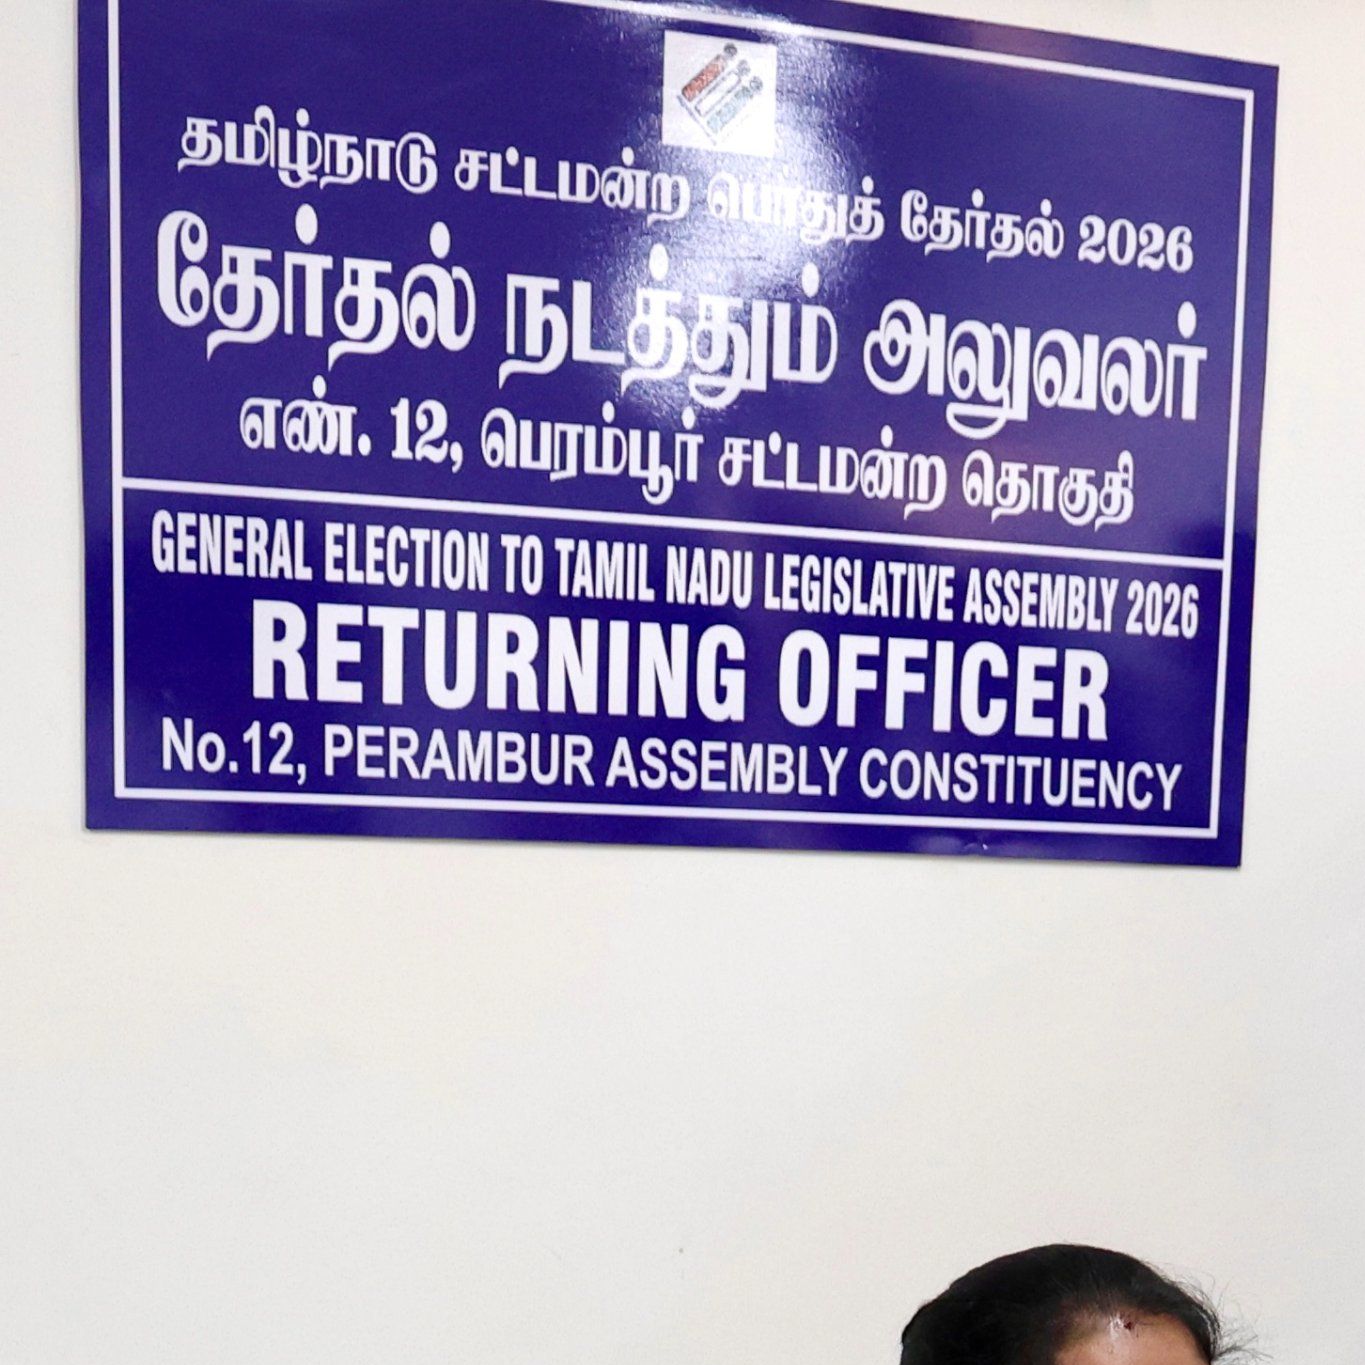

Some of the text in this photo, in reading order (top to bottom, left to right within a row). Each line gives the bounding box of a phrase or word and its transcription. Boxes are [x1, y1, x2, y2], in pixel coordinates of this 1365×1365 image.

[177, 105, 1194, 273] தமிழ்நாடு சட்டமன்ற பொதுத் தேர்தல் 2026
[157, 203, 1207, 440] தேர்தல் நடத்தும் அலுவலர்
[239, 375, 1134, 532] எண். 12, பெரம்பூர் சட்டமன்ற தொகுதி
[152, 509, 1199, 639] GENERAL ELECTION TO TAMIL NADU LEGISLATIVE ASSEMBLY 2026
[252, 598, 1109, 742] RETURNING OFFICER
[324, 724, 595, 787] PERAMBUR
[605, 736, 849, 797] ASSEMBLY
[859, 748, 1183, 811] CONSTITUENCY
